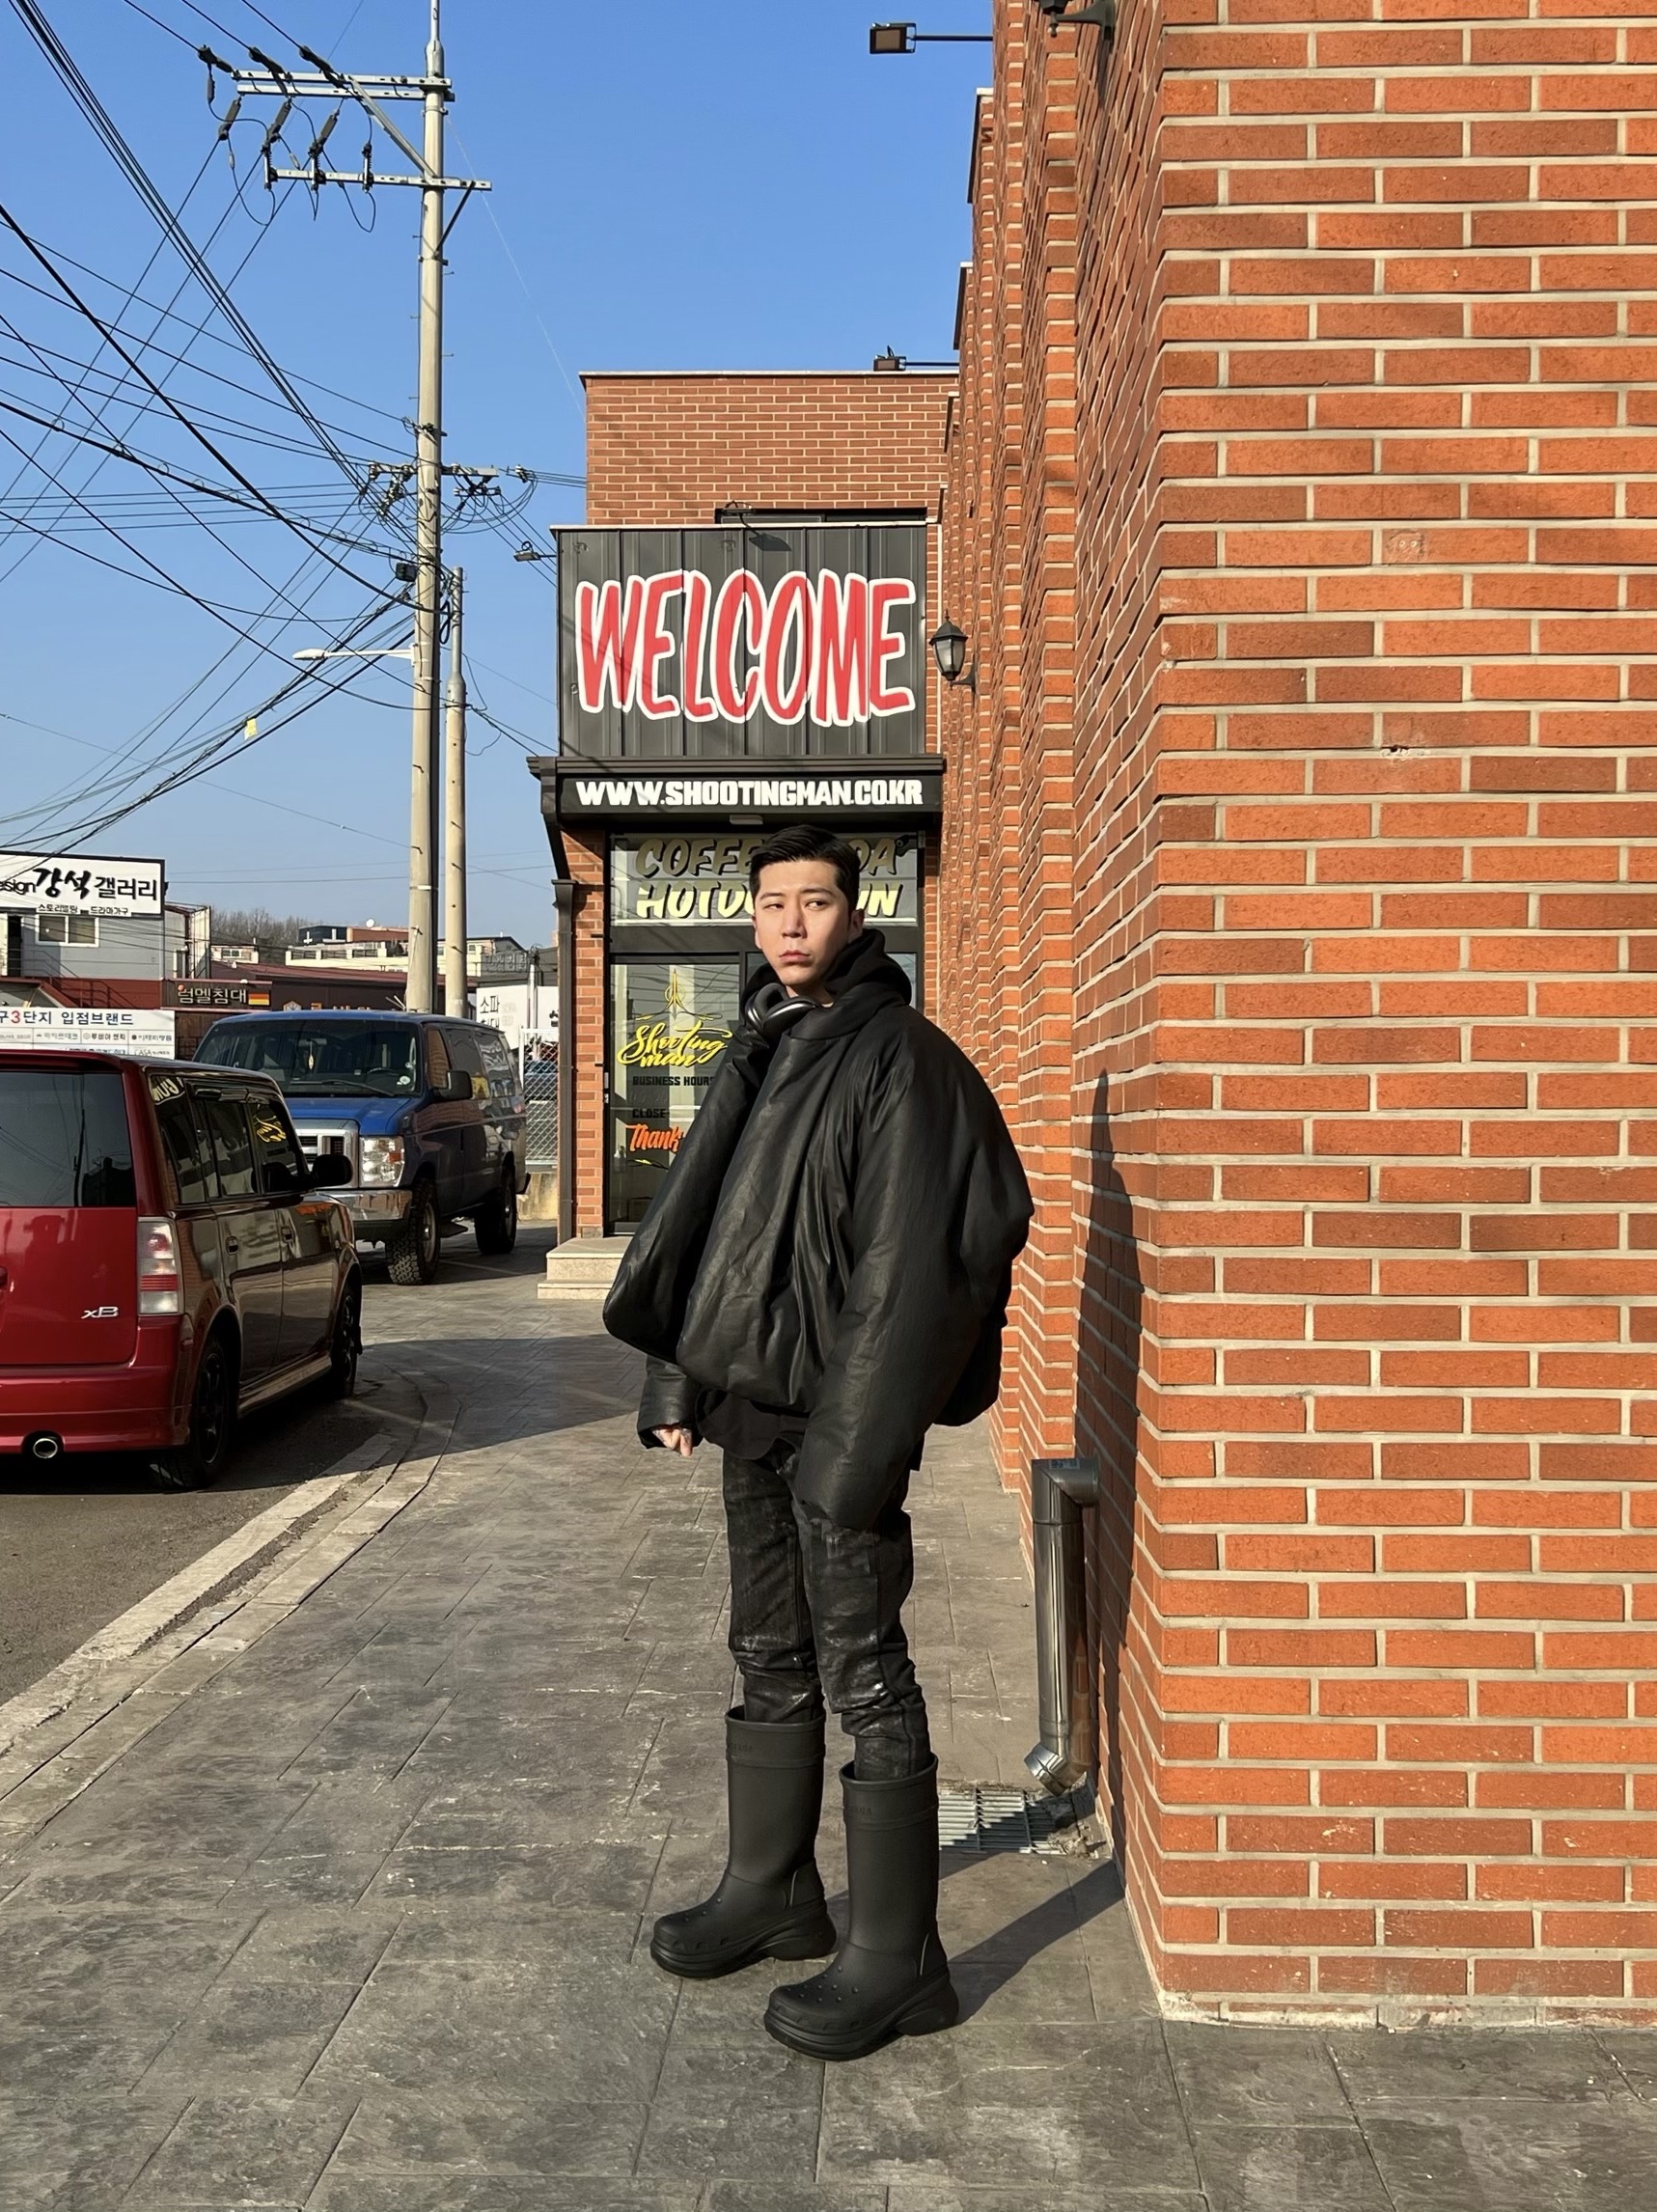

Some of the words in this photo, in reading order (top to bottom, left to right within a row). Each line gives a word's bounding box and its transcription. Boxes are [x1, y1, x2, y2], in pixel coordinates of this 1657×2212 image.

[575, 568, 916, 727] WELCOME
[576, 779, 924, 807] WWW.SHOOTINGMAN.CO.KR
[33, 868, 92, 899] 강석
[95, 876, 157, 900] 갤러리
[481, 995, 500, 1014] 소파
[61, 1011, 134, 1026] 입점브랜드
[617, 1020, 733, 1065] Shooting
[640, 1052, 701, 1067] man
[632, 1075, 681, 1087] BUSINESS
[81, 1306, 119, 1319] xB
